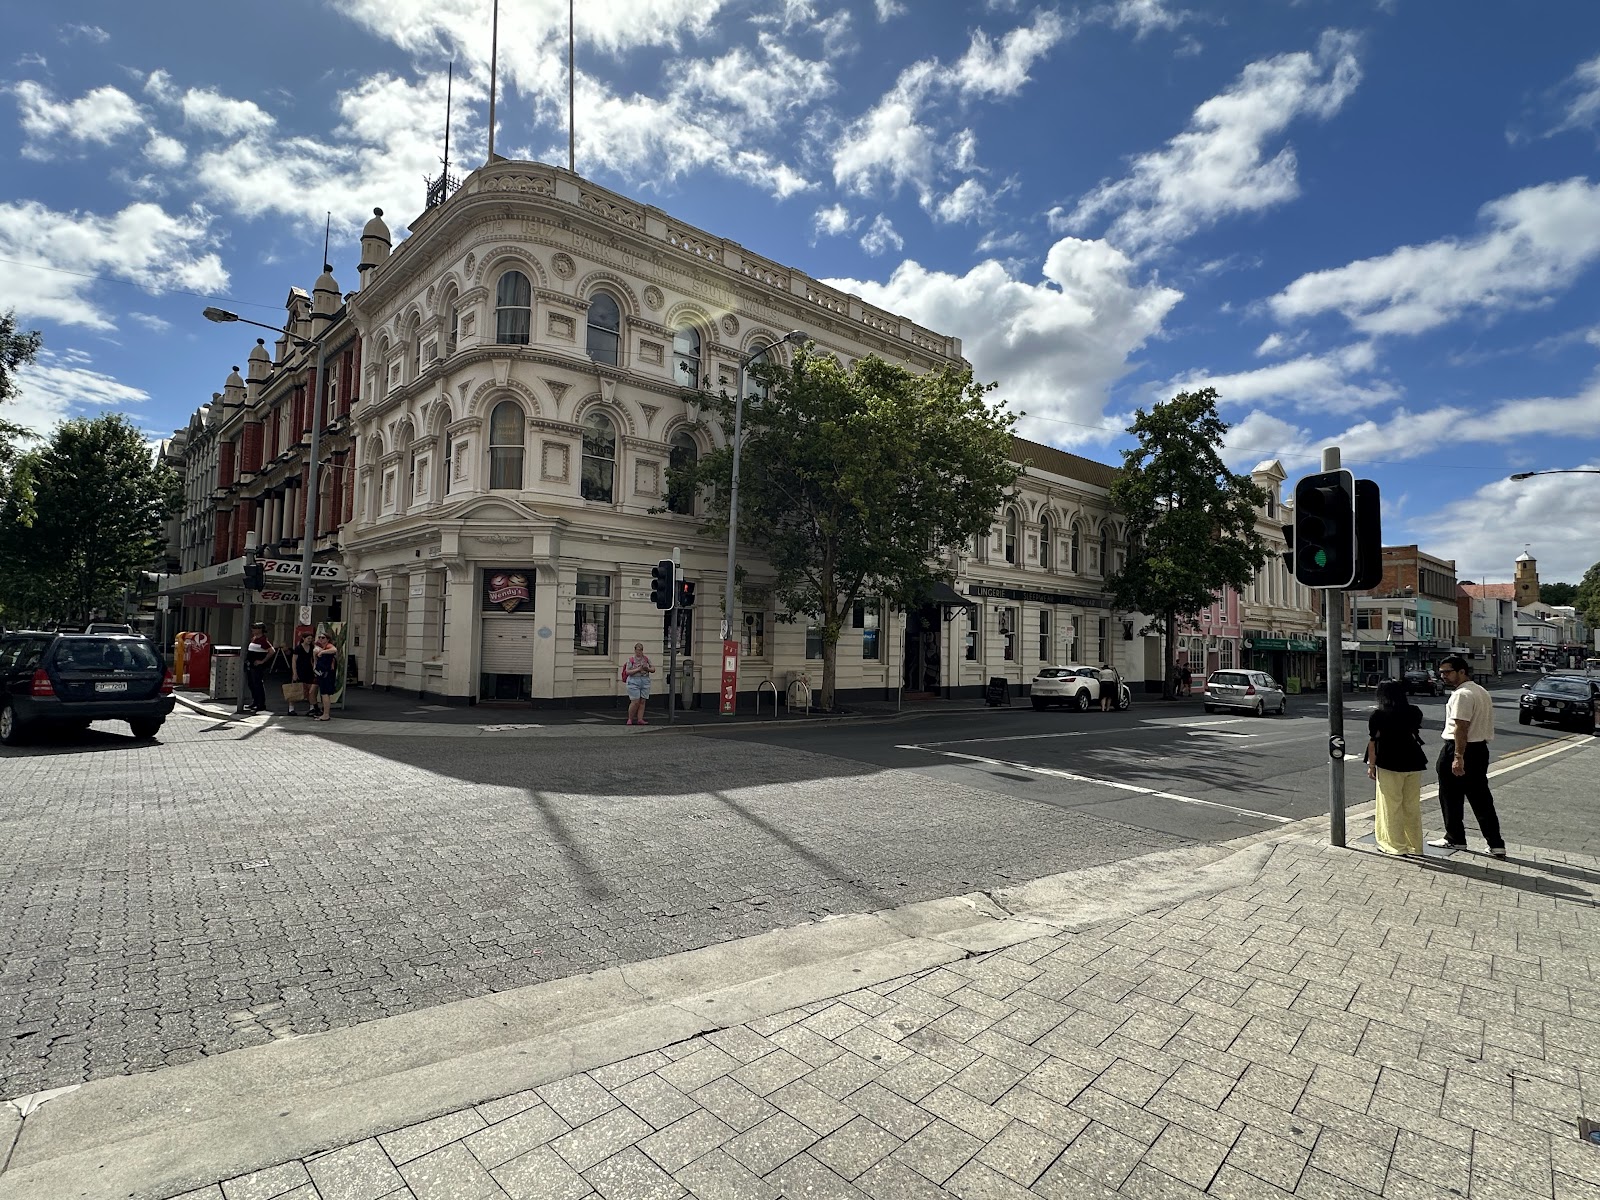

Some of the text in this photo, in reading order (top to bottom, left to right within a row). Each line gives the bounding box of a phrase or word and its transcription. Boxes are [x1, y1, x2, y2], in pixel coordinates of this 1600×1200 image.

[520, 220, 556, 238] 1817
[572, 233, 613, 259] BANK
[621, 253, 641, 269] OF
[652, 263, 681, 284] NEW
[691, 279, 732, 304] SOUTH
[261, 591, 282, 600] EB
[281, 592, 327, 603] GAES
[489, 588, 522, 600] Wendy's
[976, 586, 1006, 598] LINGERIE
[1023, 592, 1055, 603] SLEEPWEAR
